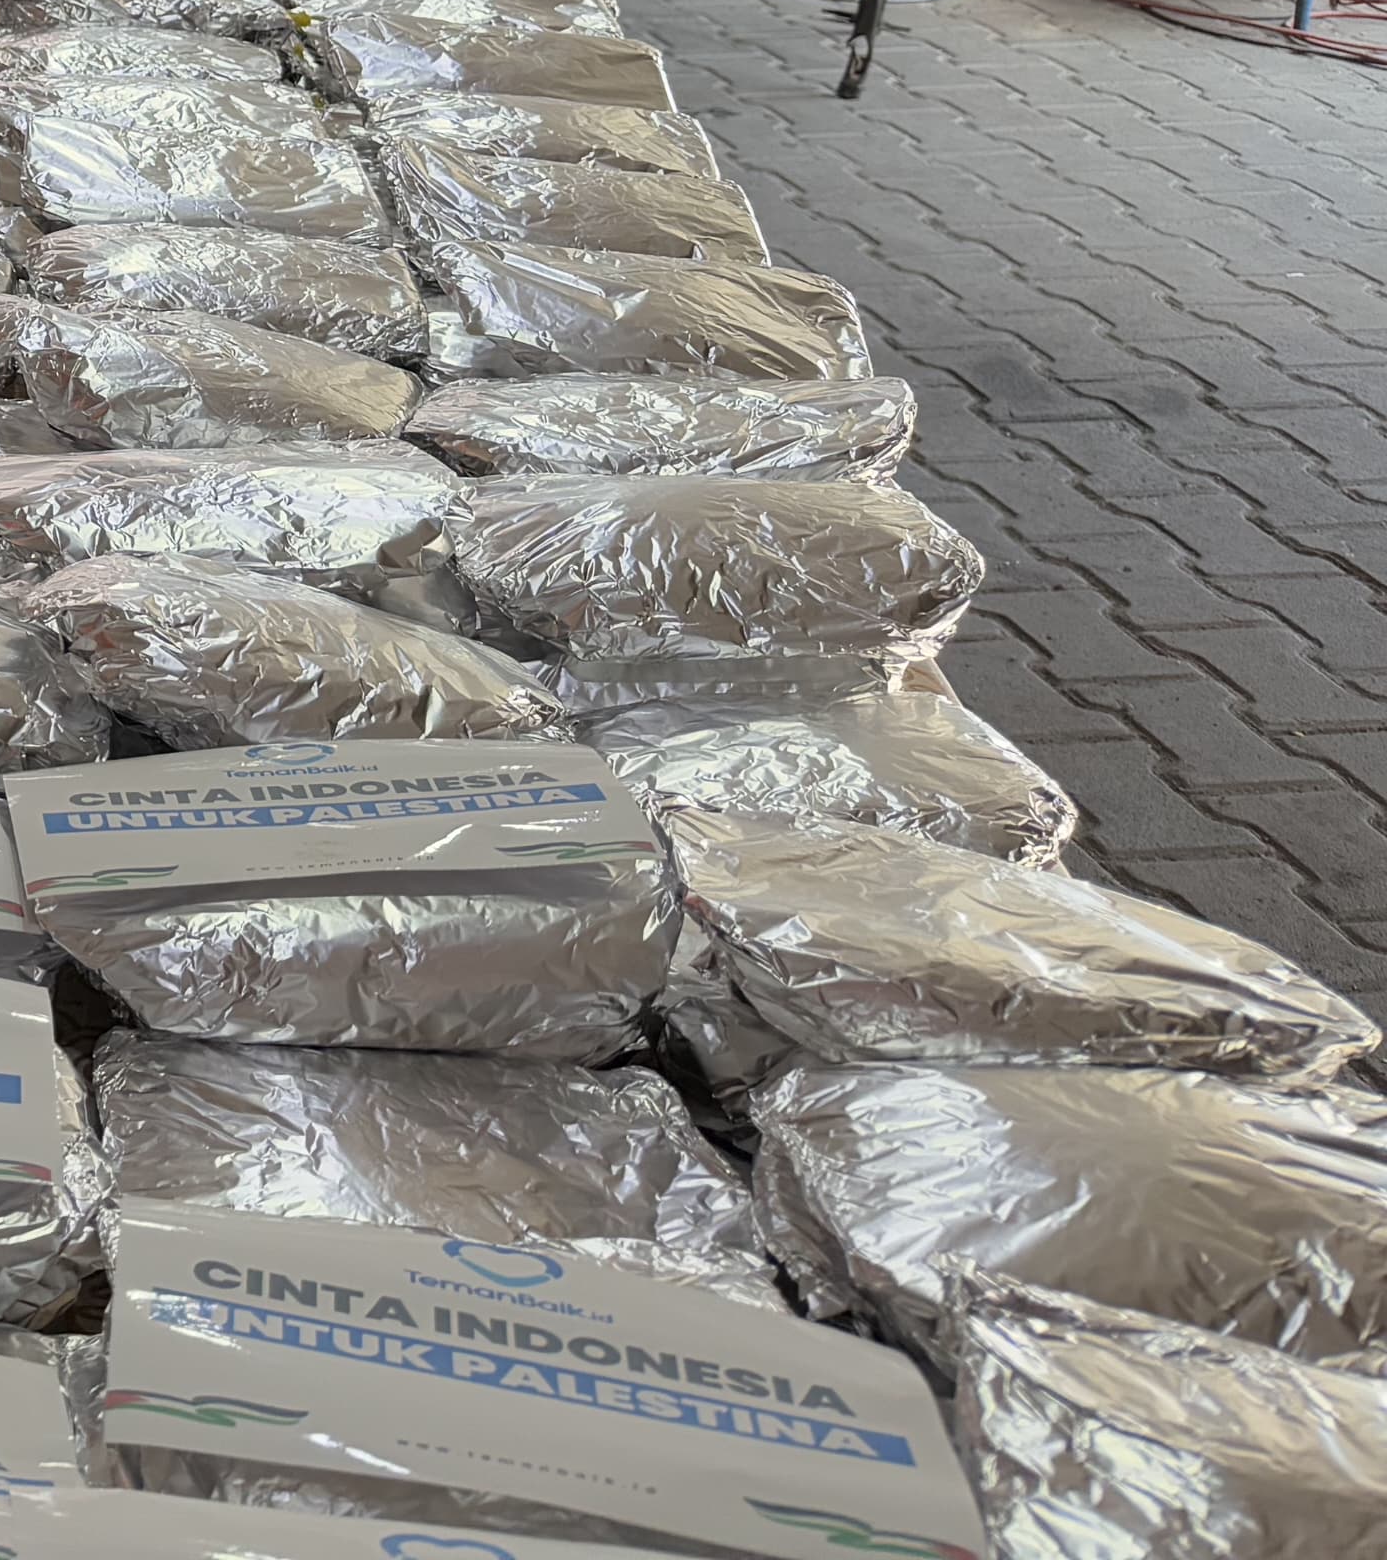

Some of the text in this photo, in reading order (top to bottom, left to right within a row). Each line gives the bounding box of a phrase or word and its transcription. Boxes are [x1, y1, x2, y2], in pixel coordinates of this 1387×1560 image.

[69, 769, 560, 807] CINTA INDONESIA
[223, 762, 379, 778] TemanBaik.id
[67, 787, 580, 830] UNTUK PALESTINA
[403, 1269, 615, 1324] TemanBaik.id
[193, 1260, 858, 1417] CINTA INDONESIA
[442, 1353, 881, 1459] PALESTINA
